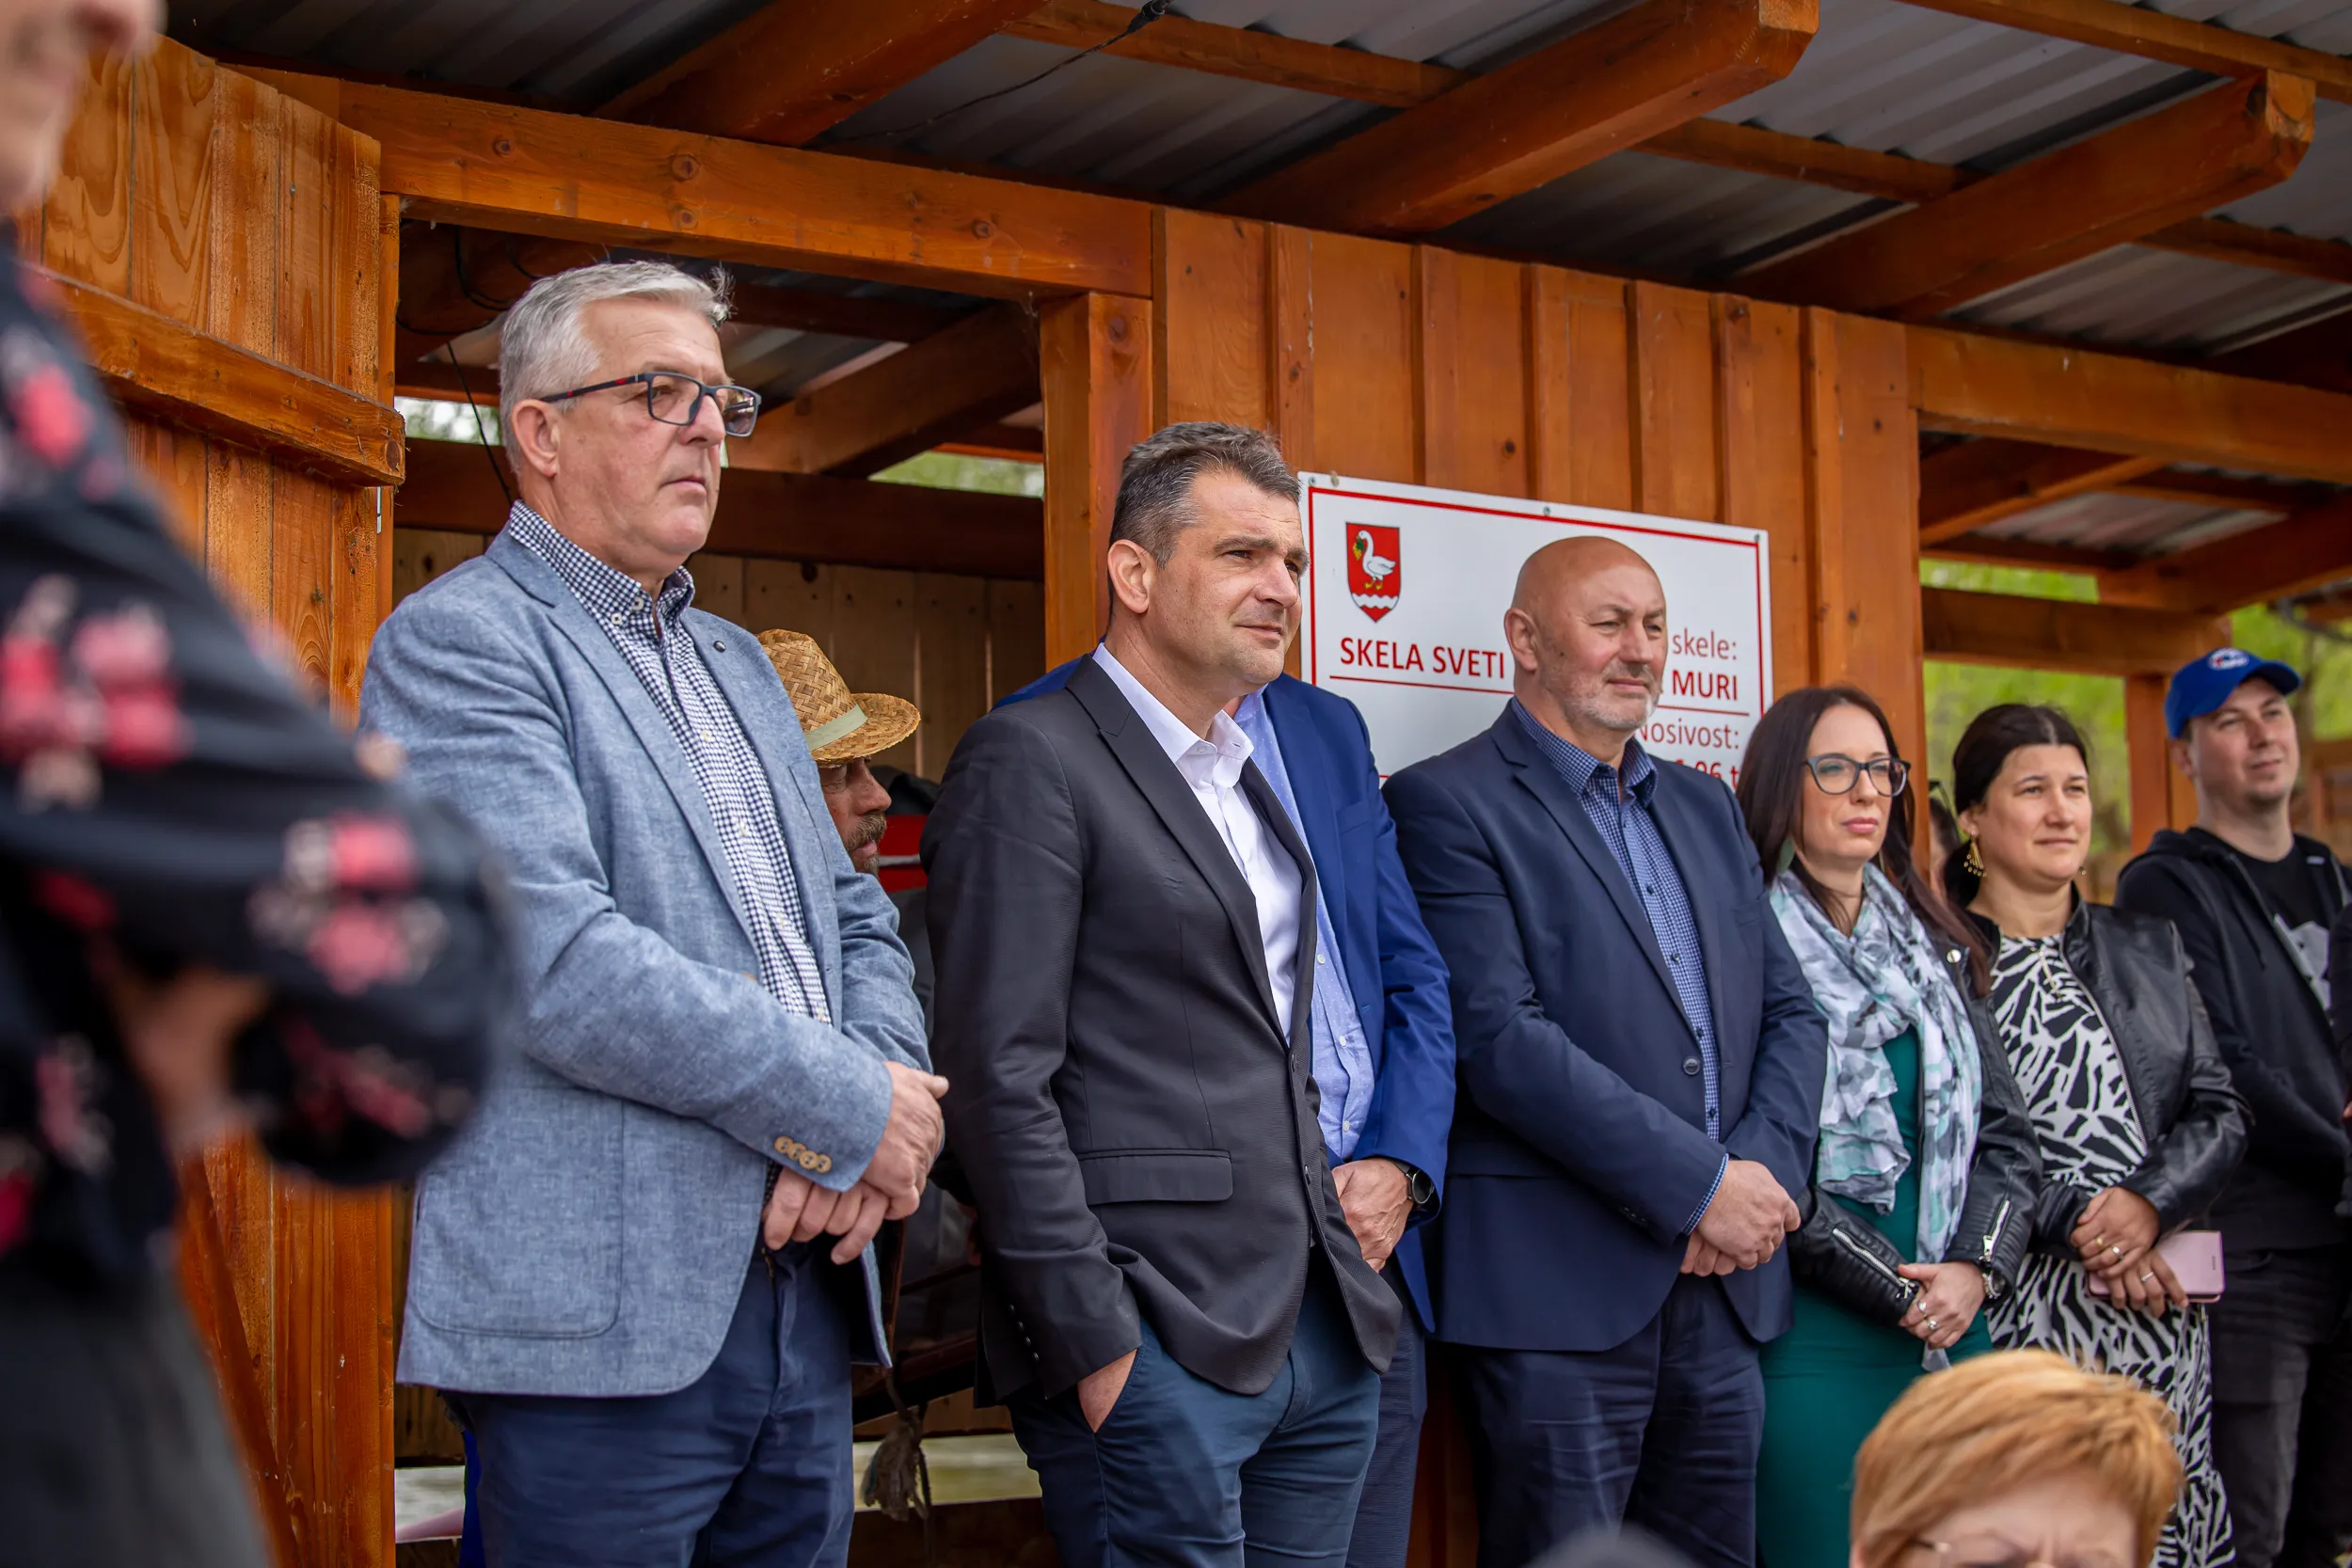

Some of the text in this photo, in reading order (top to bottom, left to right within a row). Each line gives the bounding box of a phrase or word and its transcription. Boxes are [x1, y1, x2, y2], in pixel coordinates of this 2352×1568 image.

[1672, 626, 1737, 660] skele:
[1340, 637, 1738, 701] SKELA SVETI MURI
